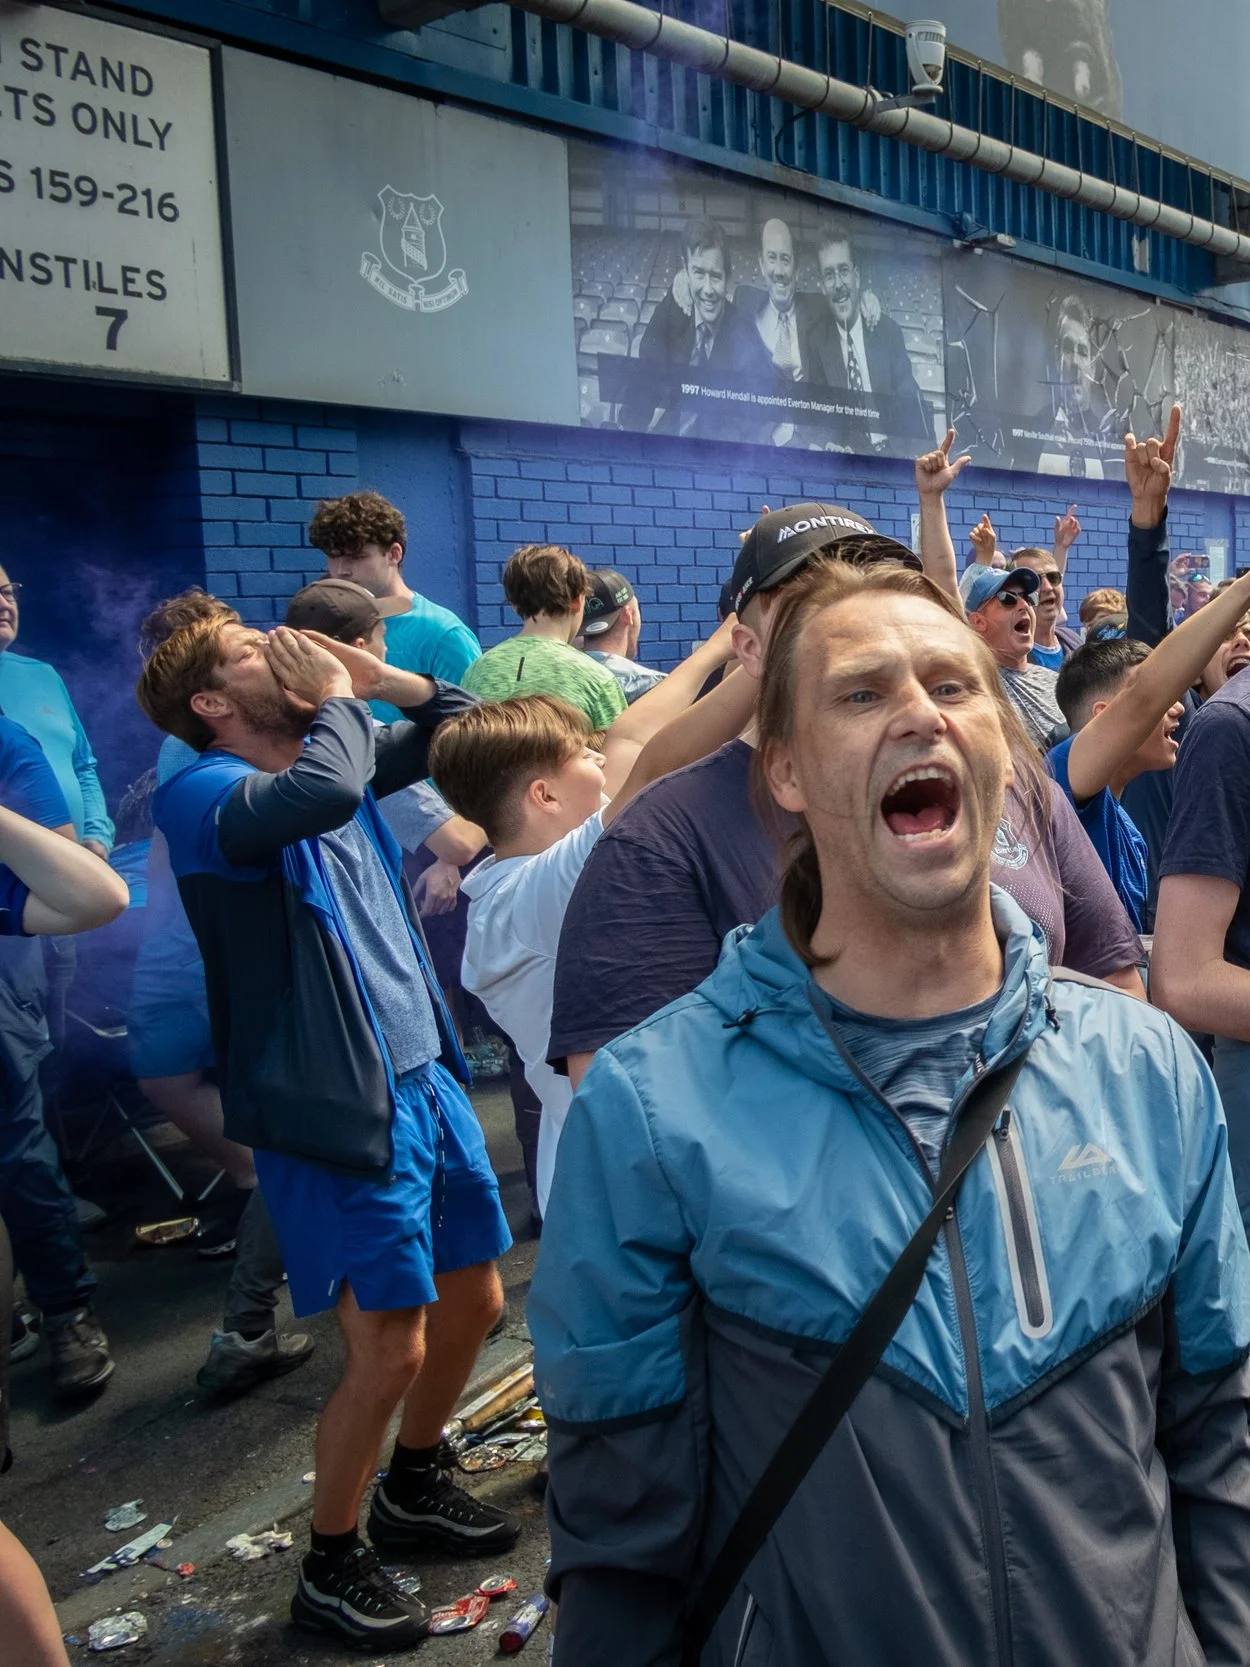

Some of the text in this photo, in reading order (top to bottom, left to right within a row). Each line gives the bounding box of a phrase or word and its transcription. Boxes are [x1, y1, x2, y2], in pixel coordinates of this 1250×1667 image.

[20, 37, 154, 98] STAND
[0, 84, 173, 152] TS ONLY
[30, 166, 180, 223] 159-216
[95, 305, 129, 351] 7
[681, 383, 880, 419] 1997 Howard Kendall is appointed Everton Manager for the third time
